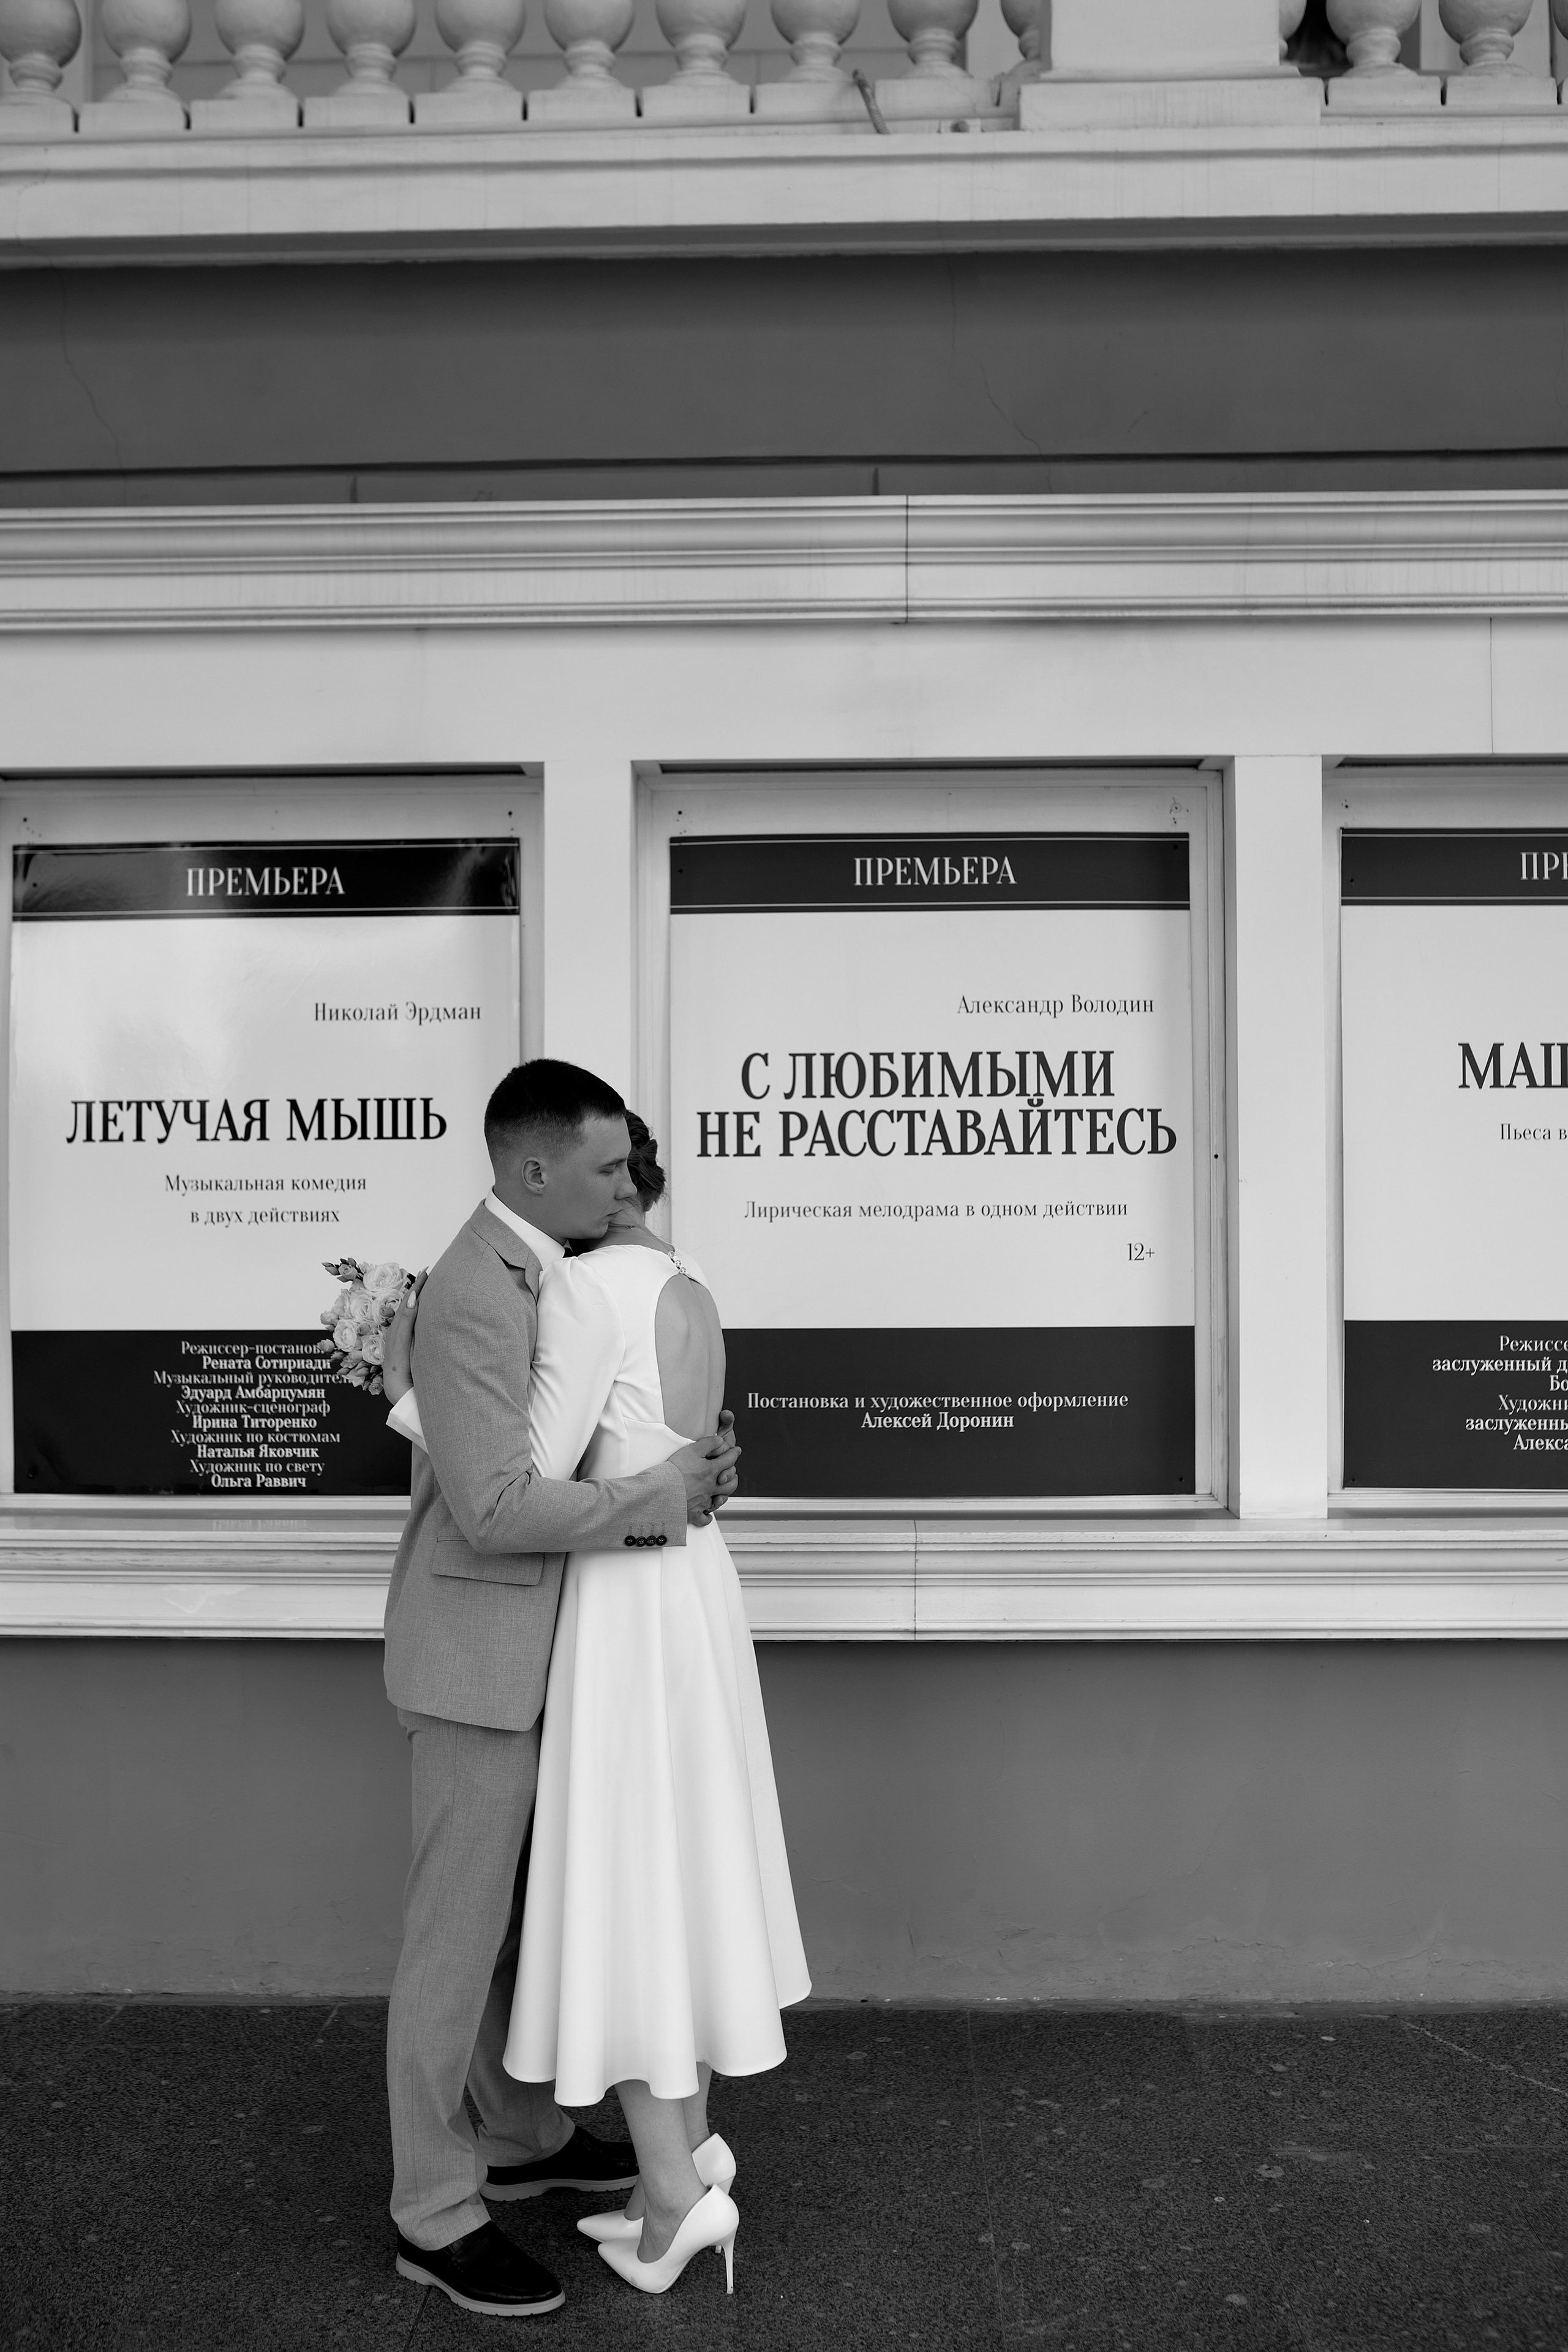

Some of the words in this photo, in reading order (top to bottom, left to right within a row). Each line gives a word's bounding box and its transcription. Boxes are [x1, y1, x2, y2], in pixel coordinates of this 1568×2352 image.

[855, 856, 1016, 885] ПРЕМЬЕРА
[186, 867, 346, 897] ПРЕМЬЕРА
[315, 1003, 398, 1021] Николай
[406, 1002, 480, 1025] Эрдман
[959, 996, 1063, 1018] Александр
[1072, 995, 1153, 1015] Володин
[742, 1053, 770, 1099] С
[783, 1051, 1115, 1100] ЛЮБИМЫМИ
[66, 1099, 270, 1144] ЛЕТУЧАЯ
[287, 1098, 447, 1141] МЫШЬ
[697, 1112, 761, 1157] НЕ
[778, 1098, 1177, 1157] РАССТАВАЙТЕСЬ
[1501, 1124, 1550, 1139] Пьеса
[1559, 1129, 1567, 1139] в
[166, 1175, 284, 1196] Музыкальная
[292, 1179, 366, 1192] комедия
[191, 1212, 199, 1223] в
[205, 1212, 242, 1228] двух
[248, 1208, 339, 1224] действиях
[745, 1202, 851, 1223] Лирическая
[860, 1205, 958, 1221] мелодрама
[967, 1205, 974, 1216] в
[982, 1205, 1036, 1218] одном
[1043, 1201, 1126, 1218] действии
[1129, 1243, 1154, 1261] 12+
[182, 1341, 325, 1358] Режиссер-постанов
[202, 1355, 251, 1370] Рената
[255, 1355, 331, 1373] Сотириади
[1432, 1357, 1552, 1376] заслуженный
[154, 1370, 254, 1387] Музыкальный
[258, 1373, 352, 1387] руководител
[181, 1385, 232, 1402] Эдуард
[235, 1385, 325, 1402] Амбарцумян
[748, 1393, 848, 1408] Постановка
[856, 1398, 864, 1408] и
[870, 1394, 1012, 1412] художественное
[1018, 1392, 1128, 1412] оформление
[176, 1400, 330, 1417] Художник-сценограф
[192, 1414, 238, 1432] Ирина
[241, 1415, 317, 1432] Титоренко
[861, 1411, 932, 1428] Алексей
[937, 1412, 1014, 1432] Доронин
[171, 1430, 242, 1446] Художник
[246, 1433, 263, 1443] по
[268, 1433, 341, 1443] костюмам
[197, 1444, 255, 1458] Наталья
[258, 1444, 319, 1458] Яковчик
[190, 1459, 261, 1476] Художник
[265, 1462, 282, 1472] по
[286, 1462, 325, 1476] свету
[211, 1474, 252, 1487] Ольга
[256, 1474, 306, 1487] Раввич
